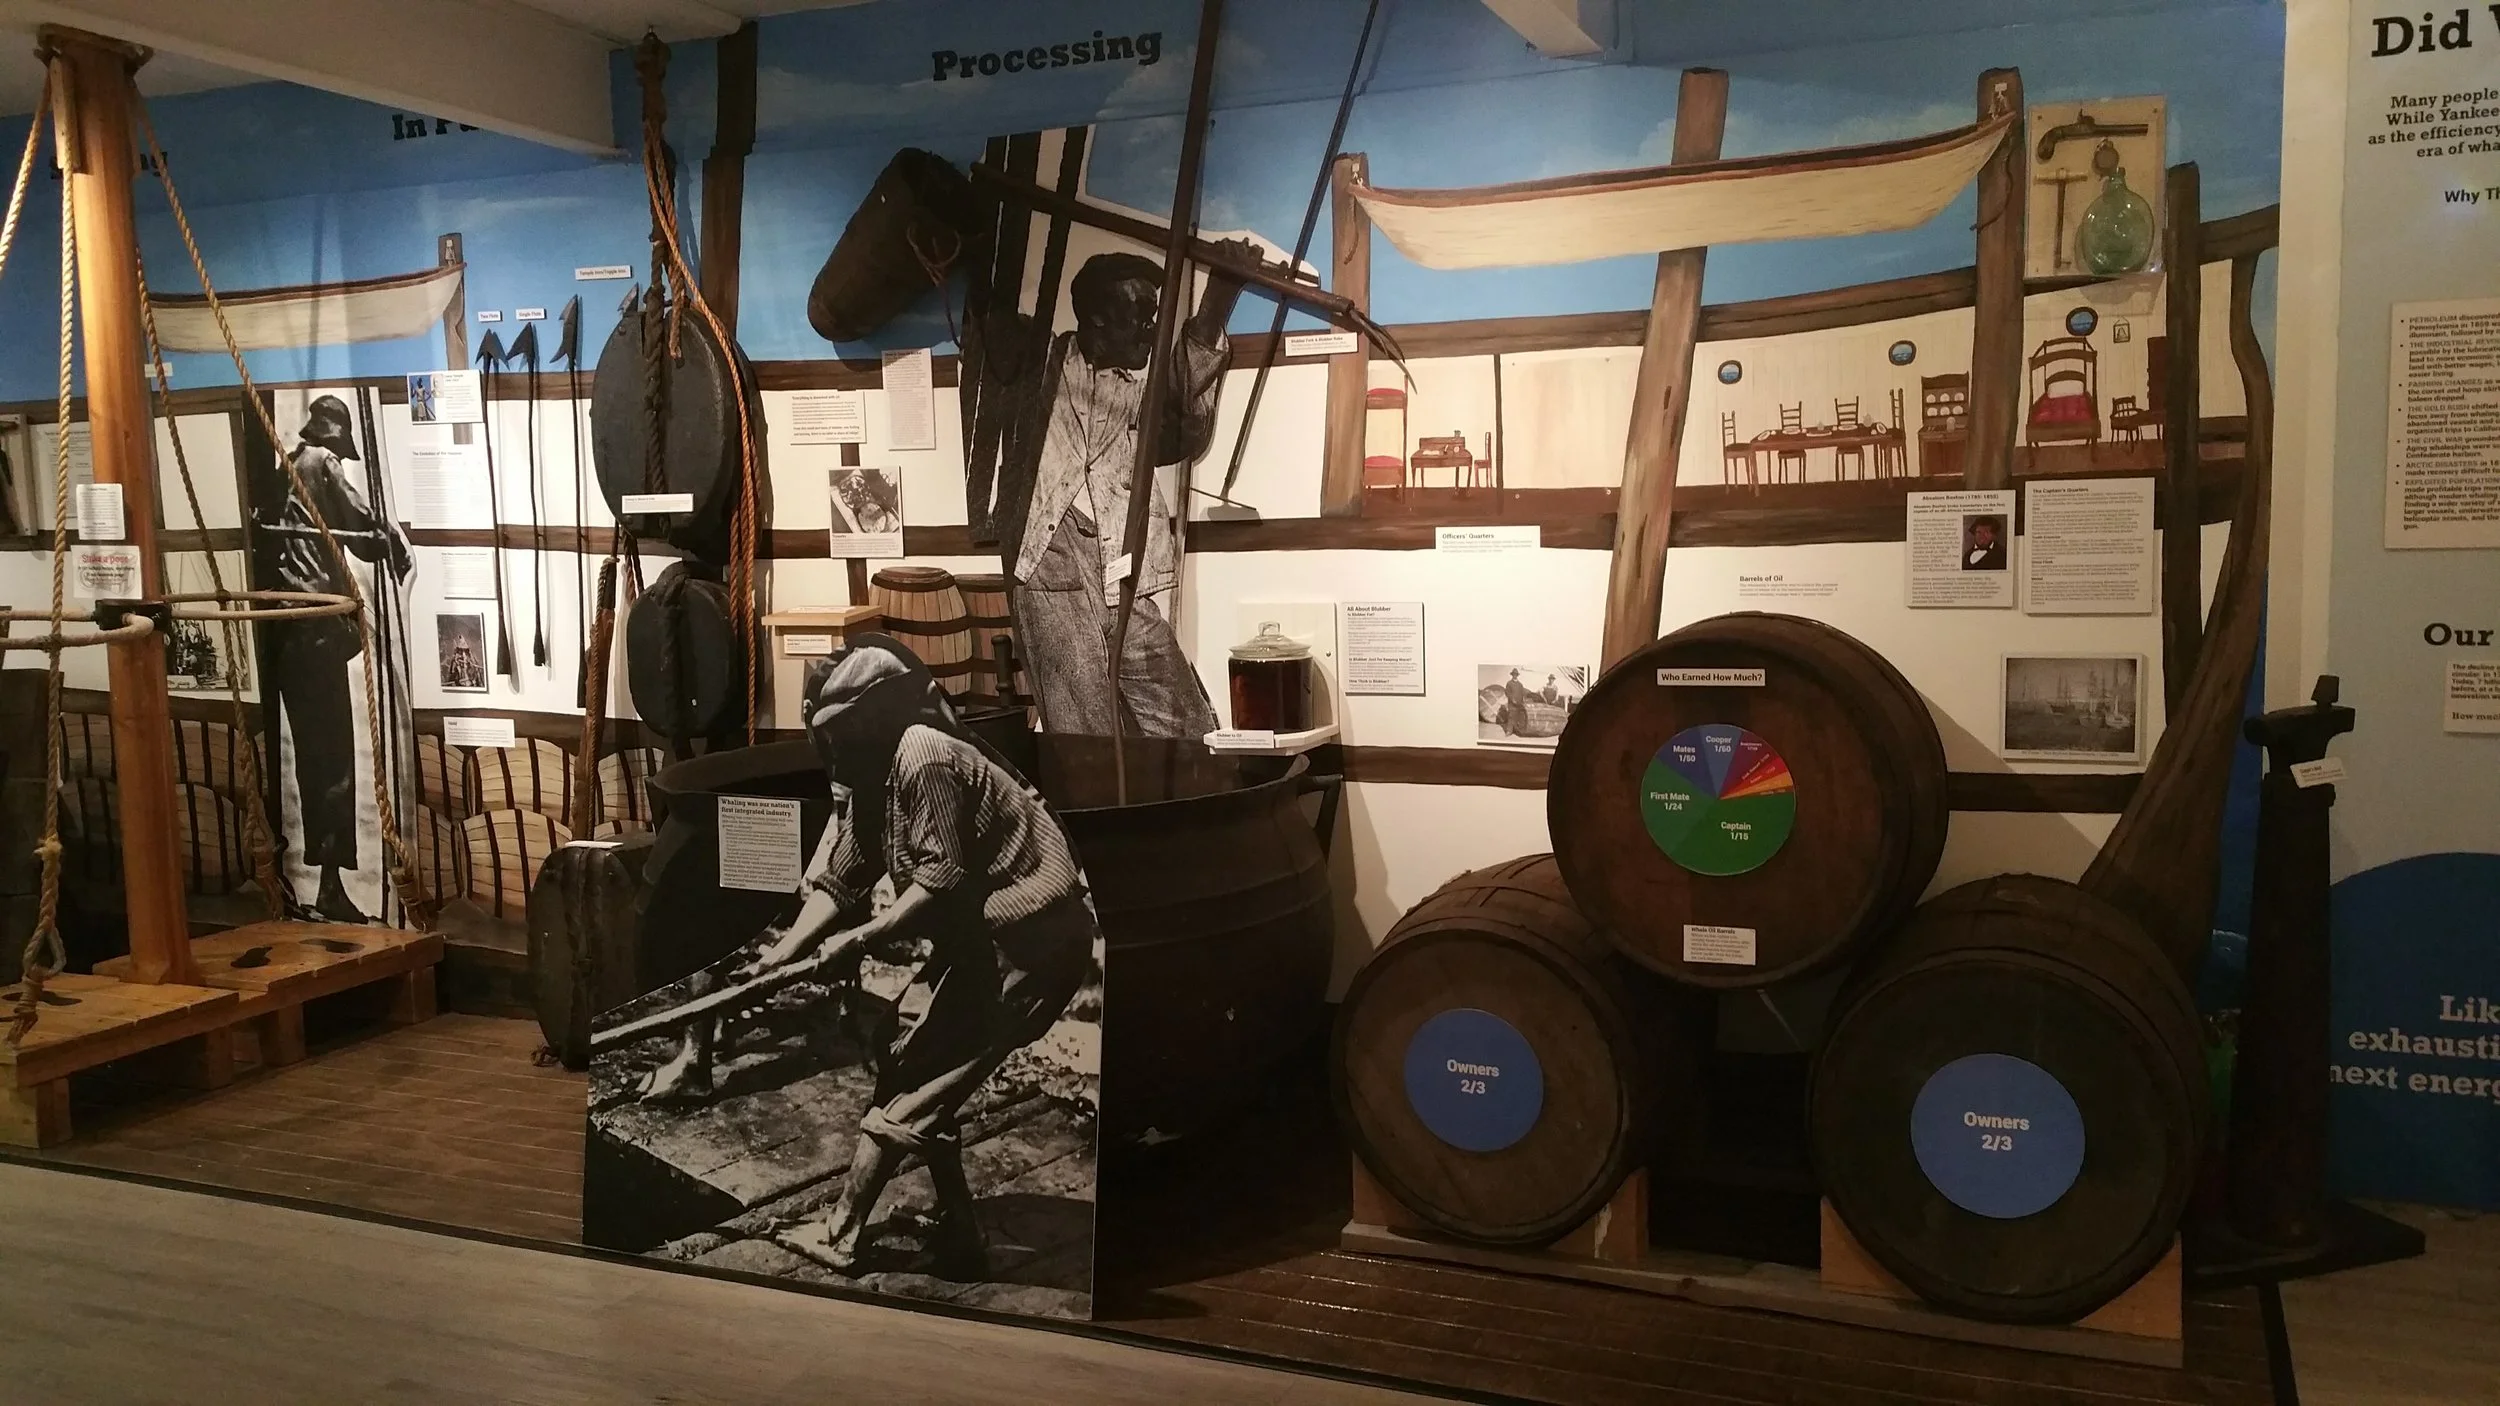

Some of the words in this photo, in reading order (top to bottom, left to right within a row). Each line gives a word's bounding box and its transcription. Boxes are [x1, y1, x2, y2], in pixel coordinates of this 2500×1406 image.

[2371, 9, 2472, 57] Did
[932, 30, 1162, 81] Processing
[2391, 95, 2437, 108] Many
[2443, 88, 2498, 107] people
[2386, 111, 2434, 125] While
[2440, 107, 2500, 121] Yankee
[392, 114, 427, 140] In
[2368, 134, 2385, 145] as
[2390, 131, 2415, 143] the
[2421, 124, 2500, 140] efficiency
[2417, 146, 2443, 157] era
[2448, 143, 2464, 155] of
[2444, 190, 2480, 203] Why
[2424, 622, 2494, 646] Our
[1661, 673, 1679, 681] Who
[1682, 673, 1710, 681] Earned
[1713, 673, 1731, 681] How
[1734, 673, 1762, 681] Much?
[1706, 736, 1732, 745] Cooper
[1673, 745, 1696, 753] Mates
[721, 799, 745, 807] Whaling
[1650, 792, 1669, 800] First
[1670, 792, 1690, 800] Mate
[1664, 803, 1682, 811] 1/24
[1721, 822, 1751, 832] Captain
[1731, 832, 1749, 840] 1/15
[1446, 1059, 1500, 1077] Owners
[2330, 1065, 2398, 1090] next
[1461, 1079, 1486, 1094] 2/3
[1964, 1111, 2030, 1131] Owners
[1981, 1134, 2013, 1151] 2/3
